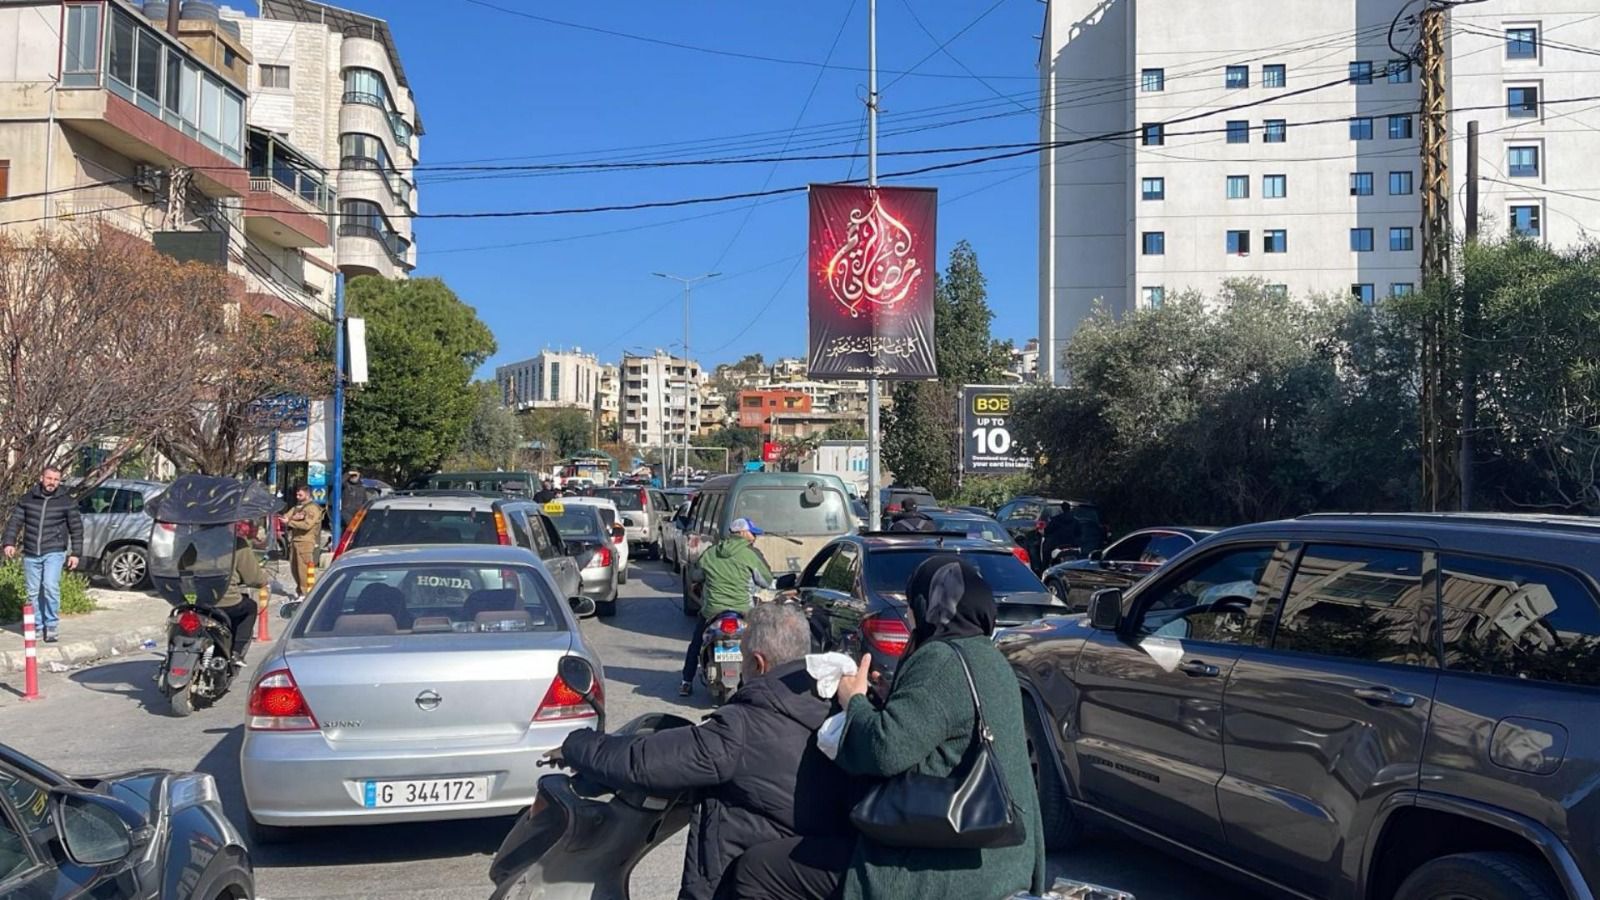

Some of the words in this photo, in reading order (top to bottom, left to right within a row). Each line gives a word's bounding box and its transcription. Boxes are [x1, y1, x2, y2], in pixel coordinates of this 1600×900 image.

[977, 398, 1010, 411] BOB
[977, 418, 990, 426] UP
[992, 418, 1005, 426] TO
[416, 575, 473, 590] HONDA
[323, 720, 365, 728] SUNNY
[381, 784, 393, 803] G
[406, 780, 475, 803] 344172
